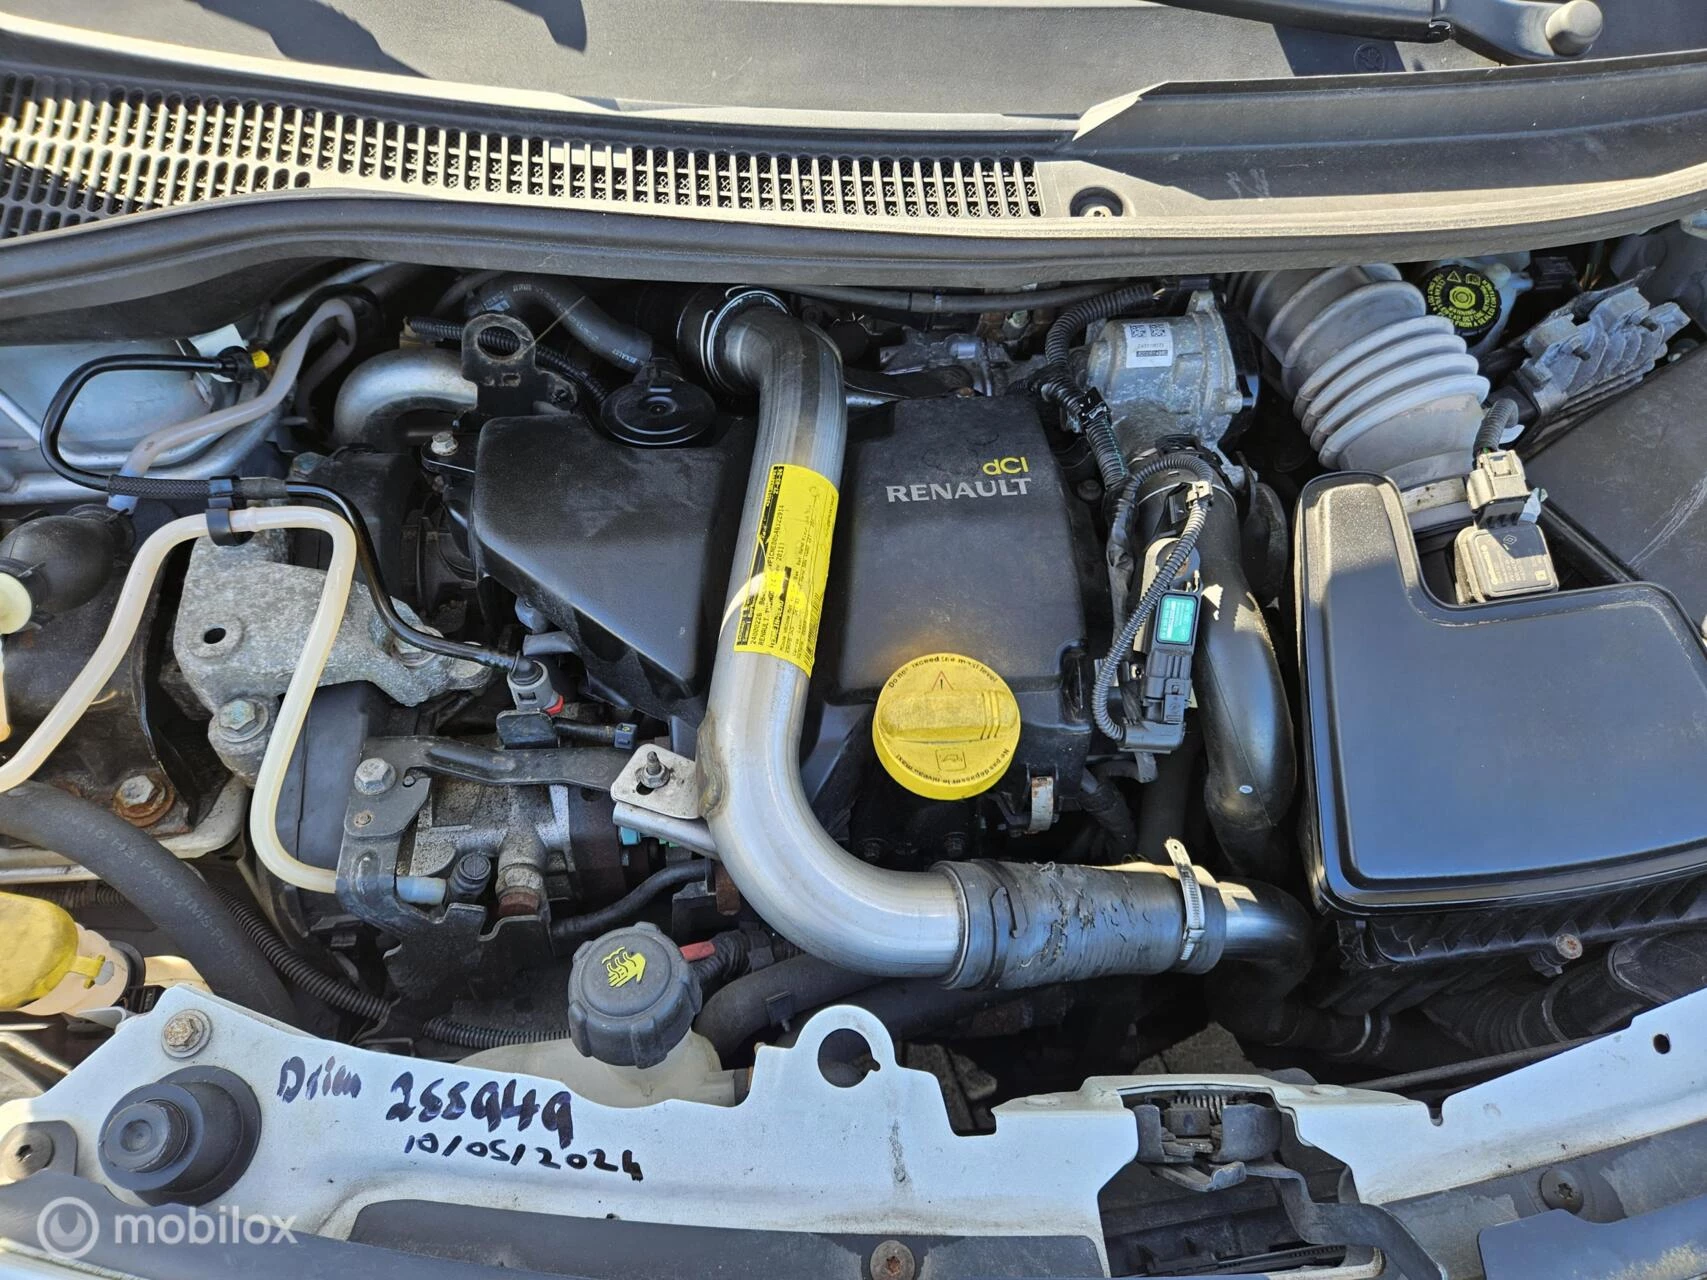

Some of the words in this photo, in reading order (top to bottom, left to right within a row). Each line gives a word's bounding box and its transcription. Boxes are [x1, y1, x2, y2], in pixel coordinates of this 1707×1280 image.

[885, 478, 1031, 503] RENAULT
[757, 616, 770, 646] RENAULT
[404, 1132, 644, 1182] 10/05/2024
